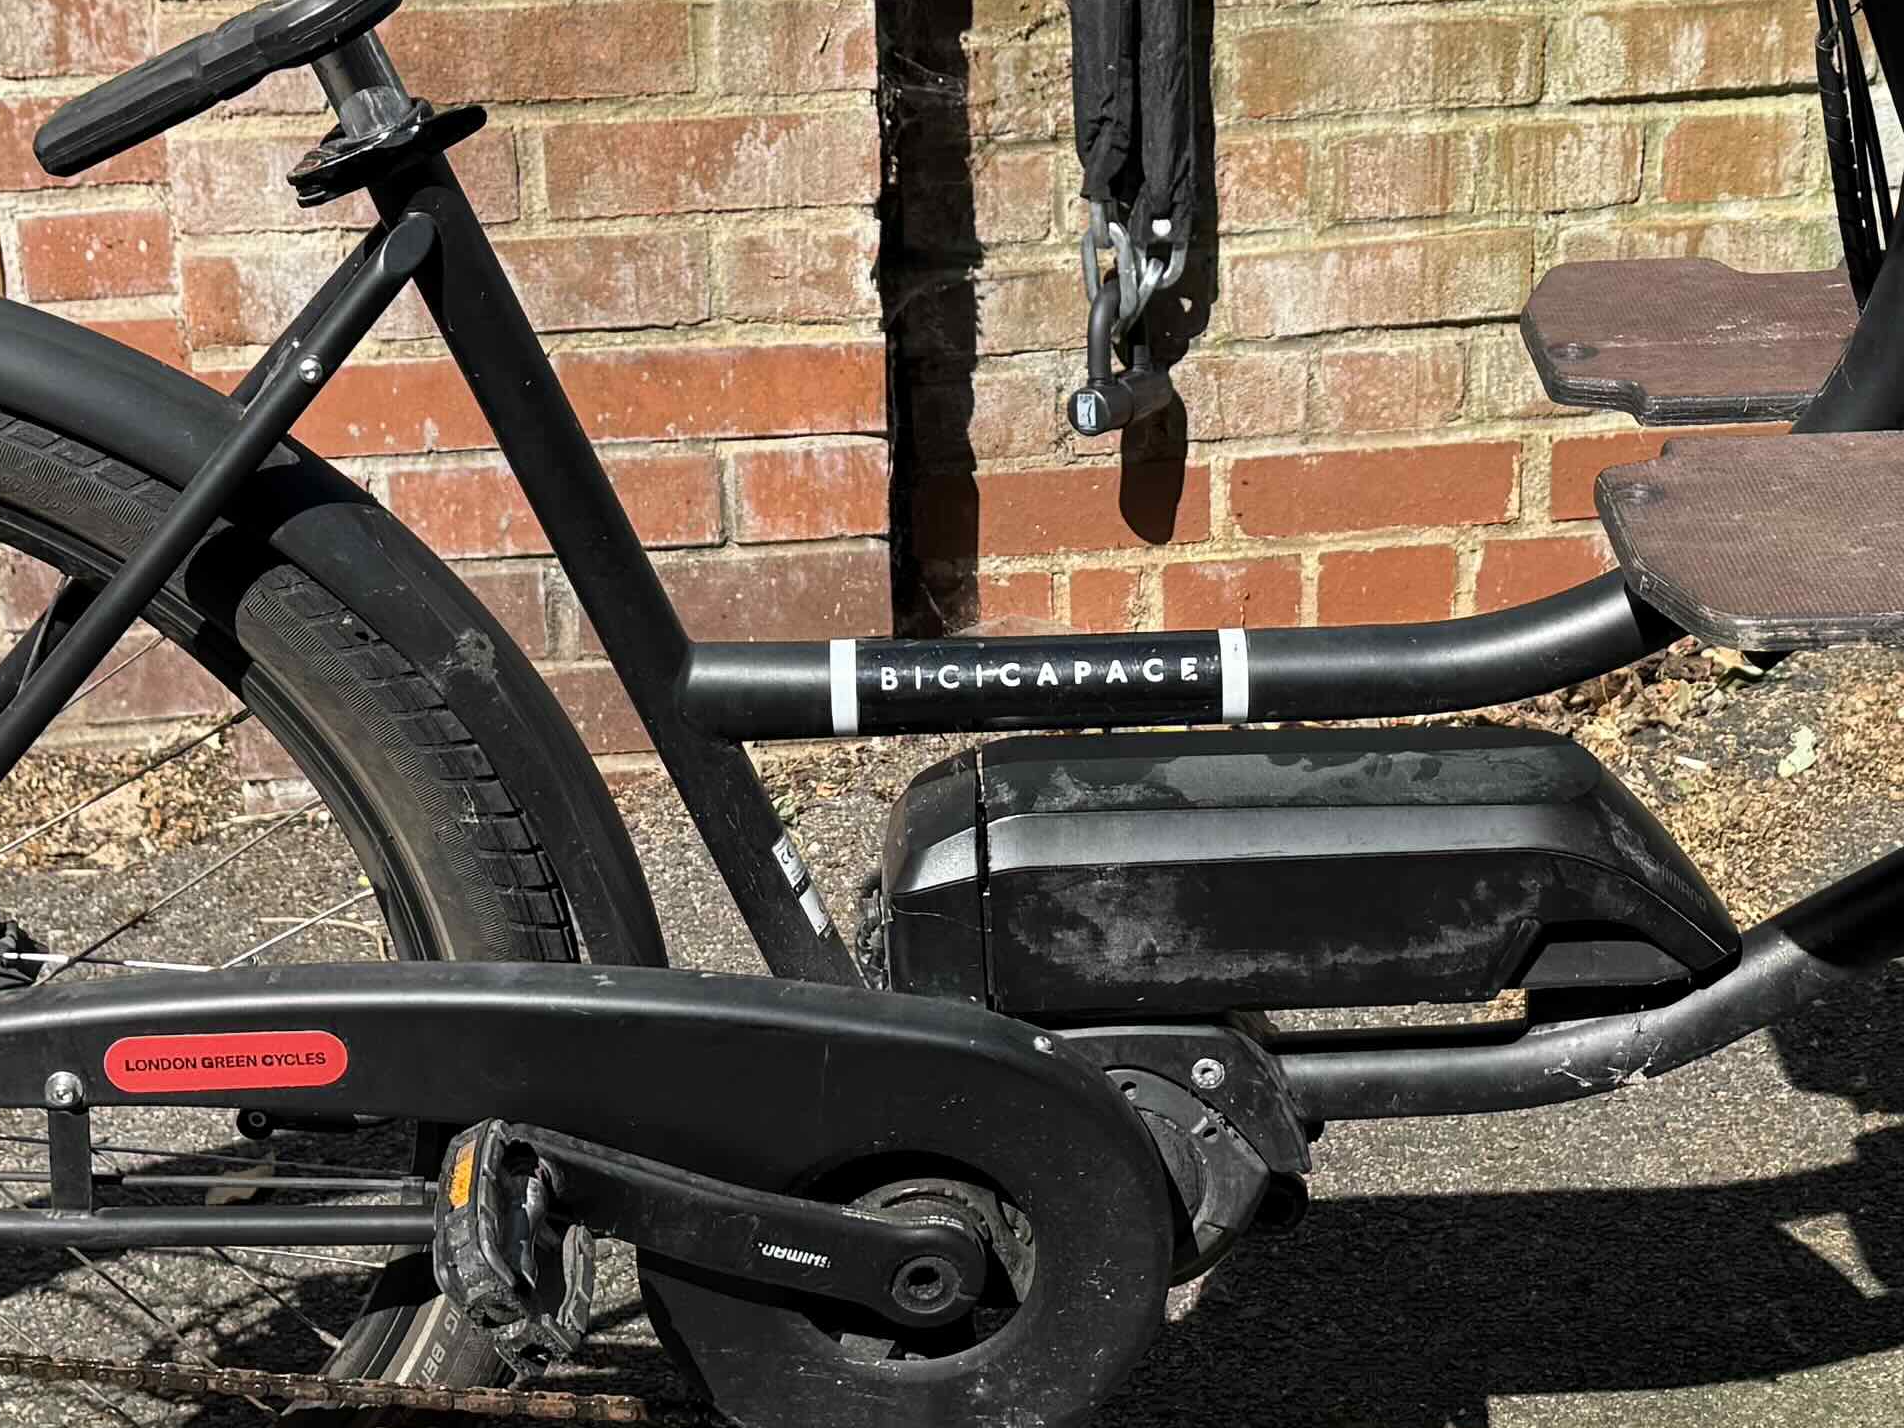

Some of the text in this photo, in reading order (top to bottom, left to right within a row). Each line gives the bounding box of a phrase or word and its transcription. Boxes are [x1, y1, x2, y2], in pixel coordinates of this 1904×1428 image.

[880, 656, 1199, 692] BICICAPACE
[124, 1050, 327, 1074] LONDON GREEN CYCLES
[443, 1307, 461, 1335] IG
